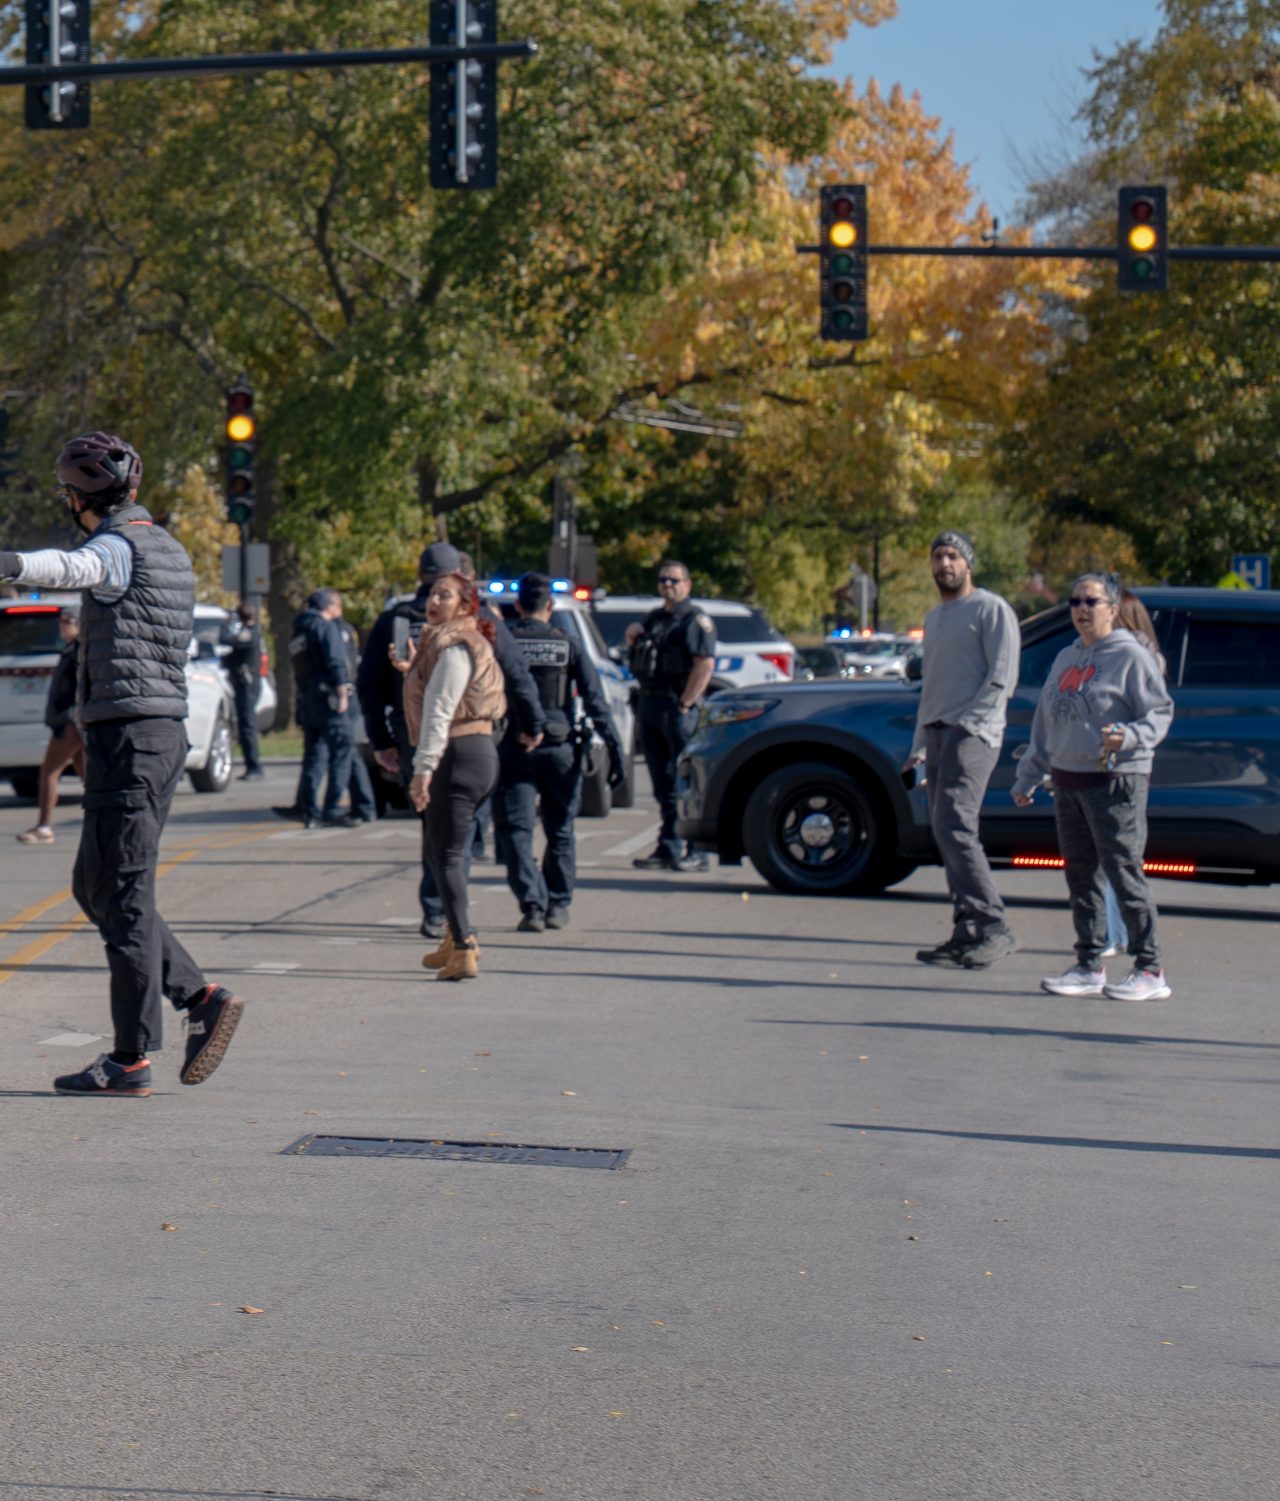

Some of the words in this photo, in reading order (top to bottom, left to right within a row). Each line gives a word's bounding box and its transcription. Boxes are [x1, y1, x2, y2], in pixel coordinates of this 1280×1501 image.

[1239, 559, 1262, 588] H
[519, 643, 565, 653] ANSTON
[525, 653, 557, 662] OLICE
